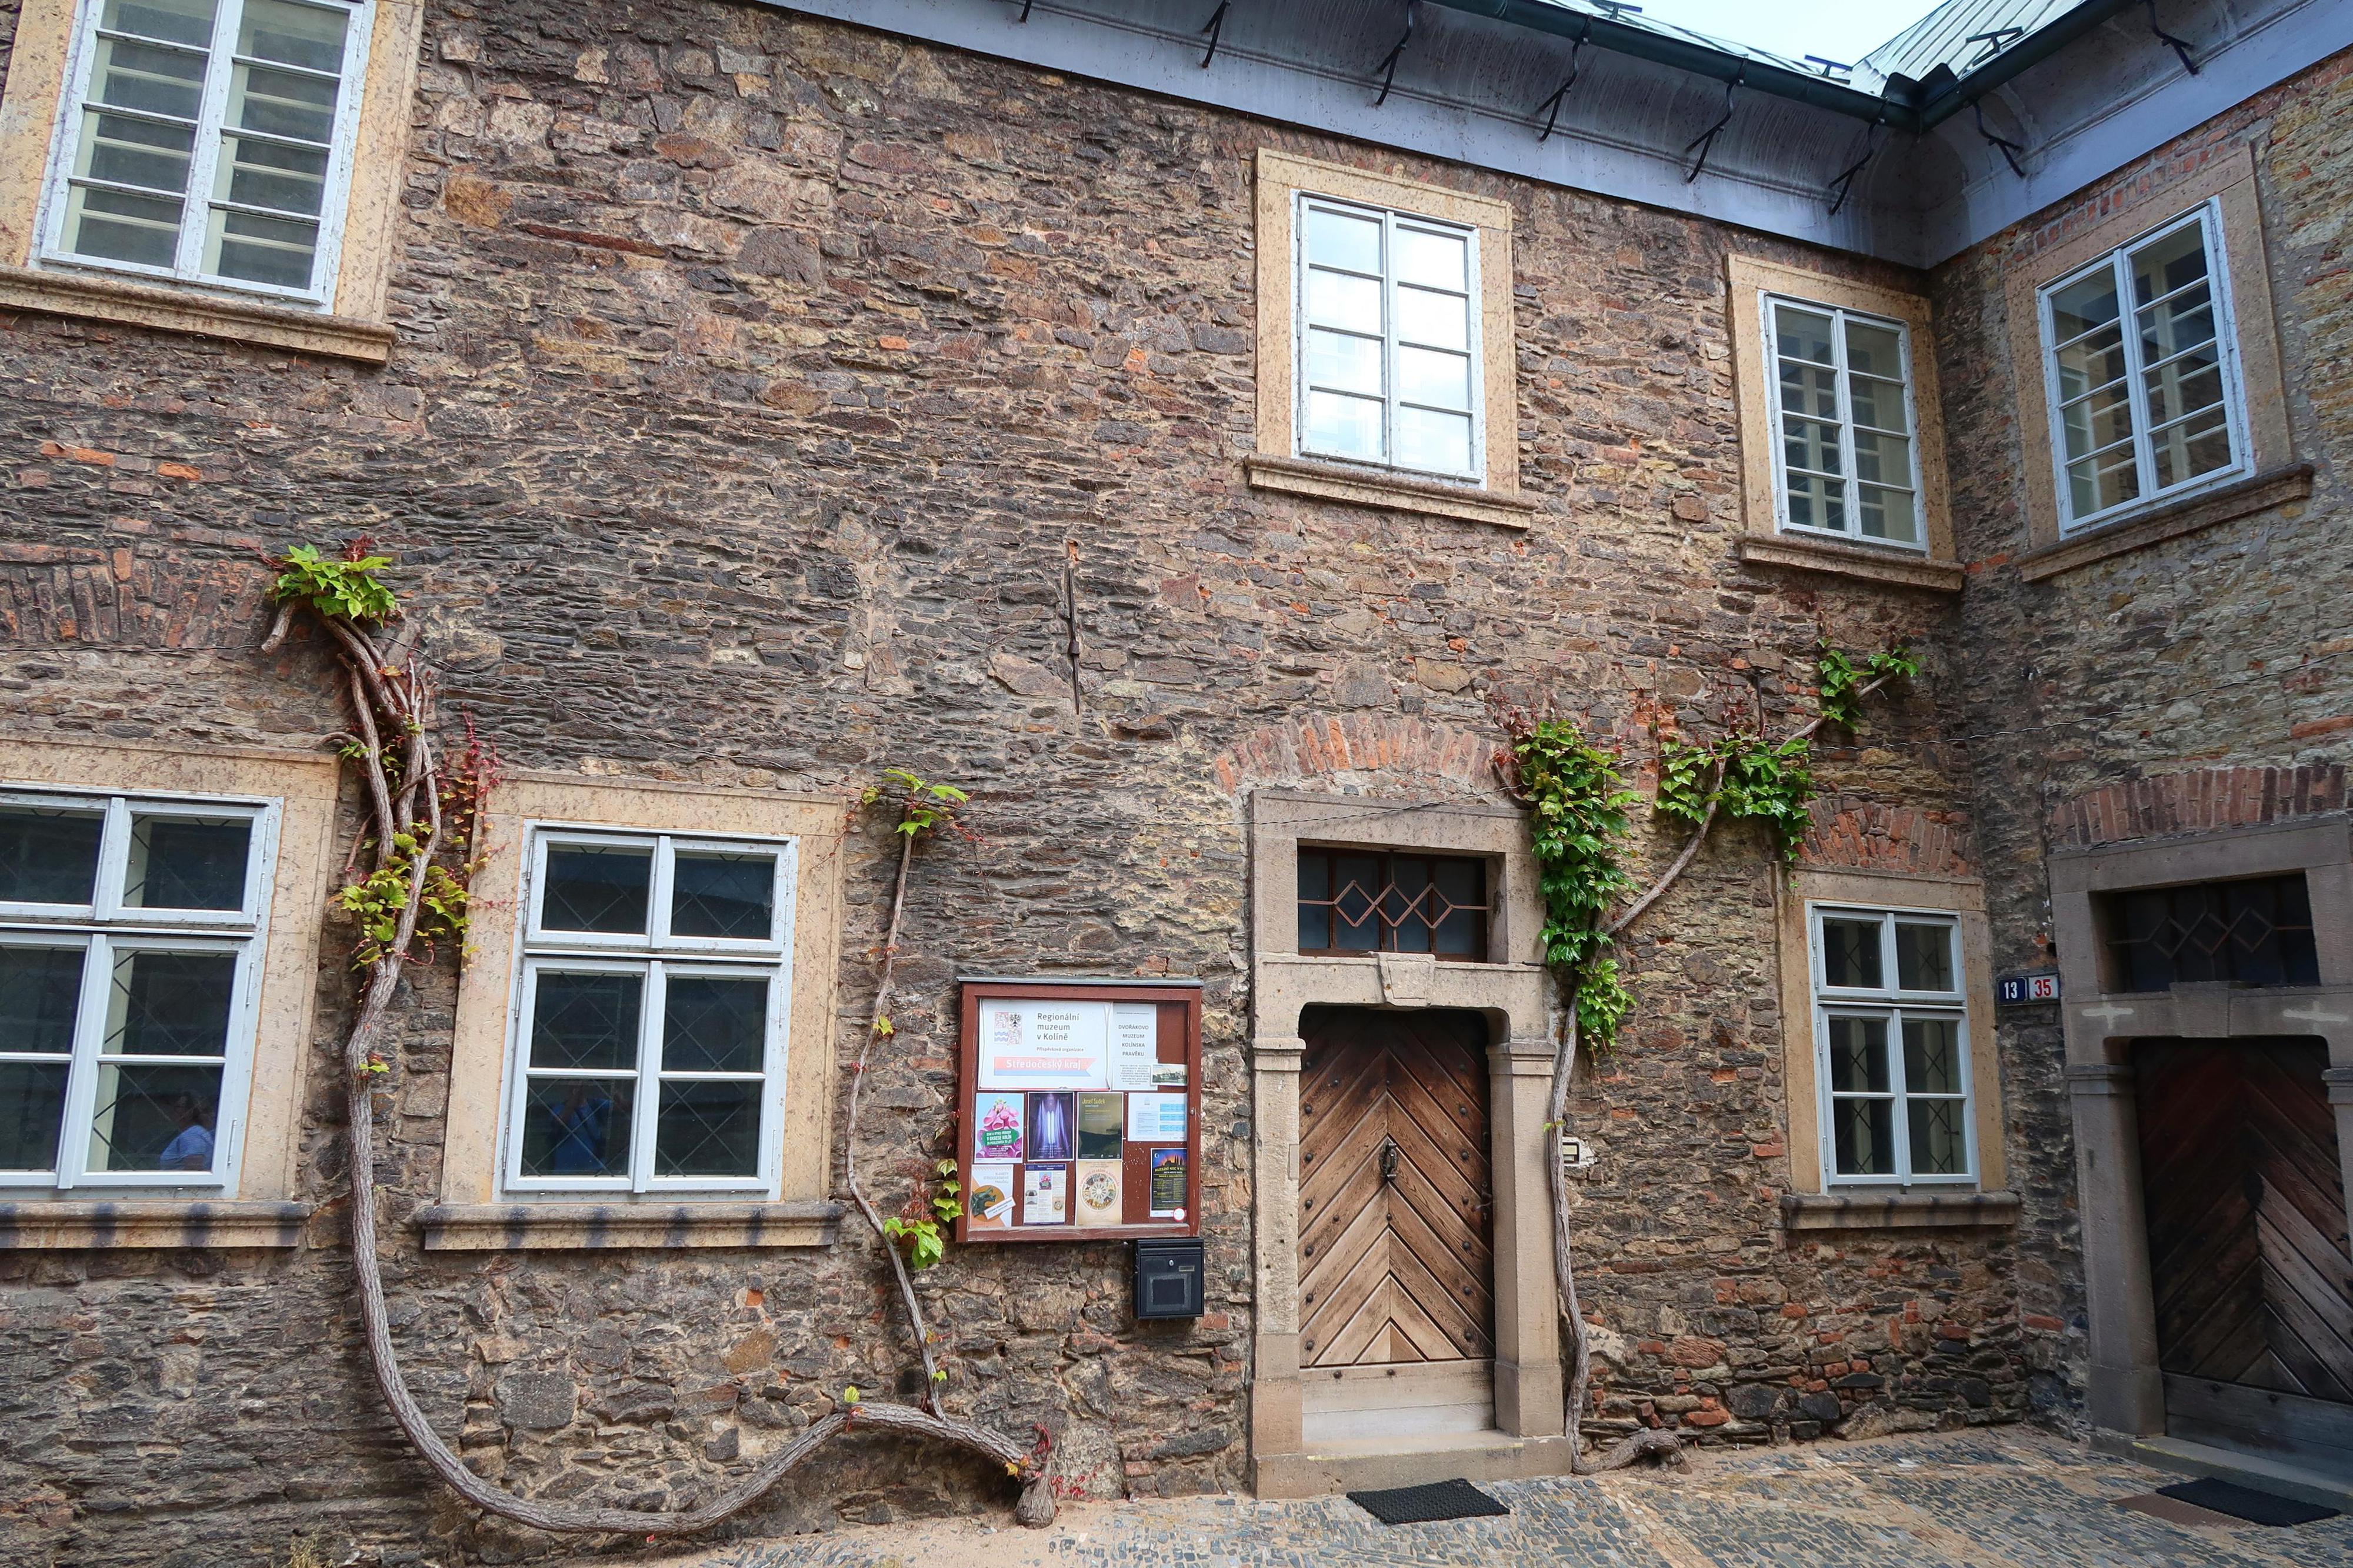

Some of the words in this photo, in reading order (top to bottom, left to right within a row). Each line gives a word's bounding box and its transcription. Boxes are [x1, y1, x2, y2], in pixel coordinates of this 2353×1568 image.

[2004, 982, 2018, 999] 13
[2034, 979, 2051, 997] 35
[1037, 1013, 1080, 1022] Regionální
[1044, 1033, 1068, 1041] Kolíně
[1006, 1059, 1062, 1070] Středočeský
[1064, 1059, 1081, 1070] kraj
